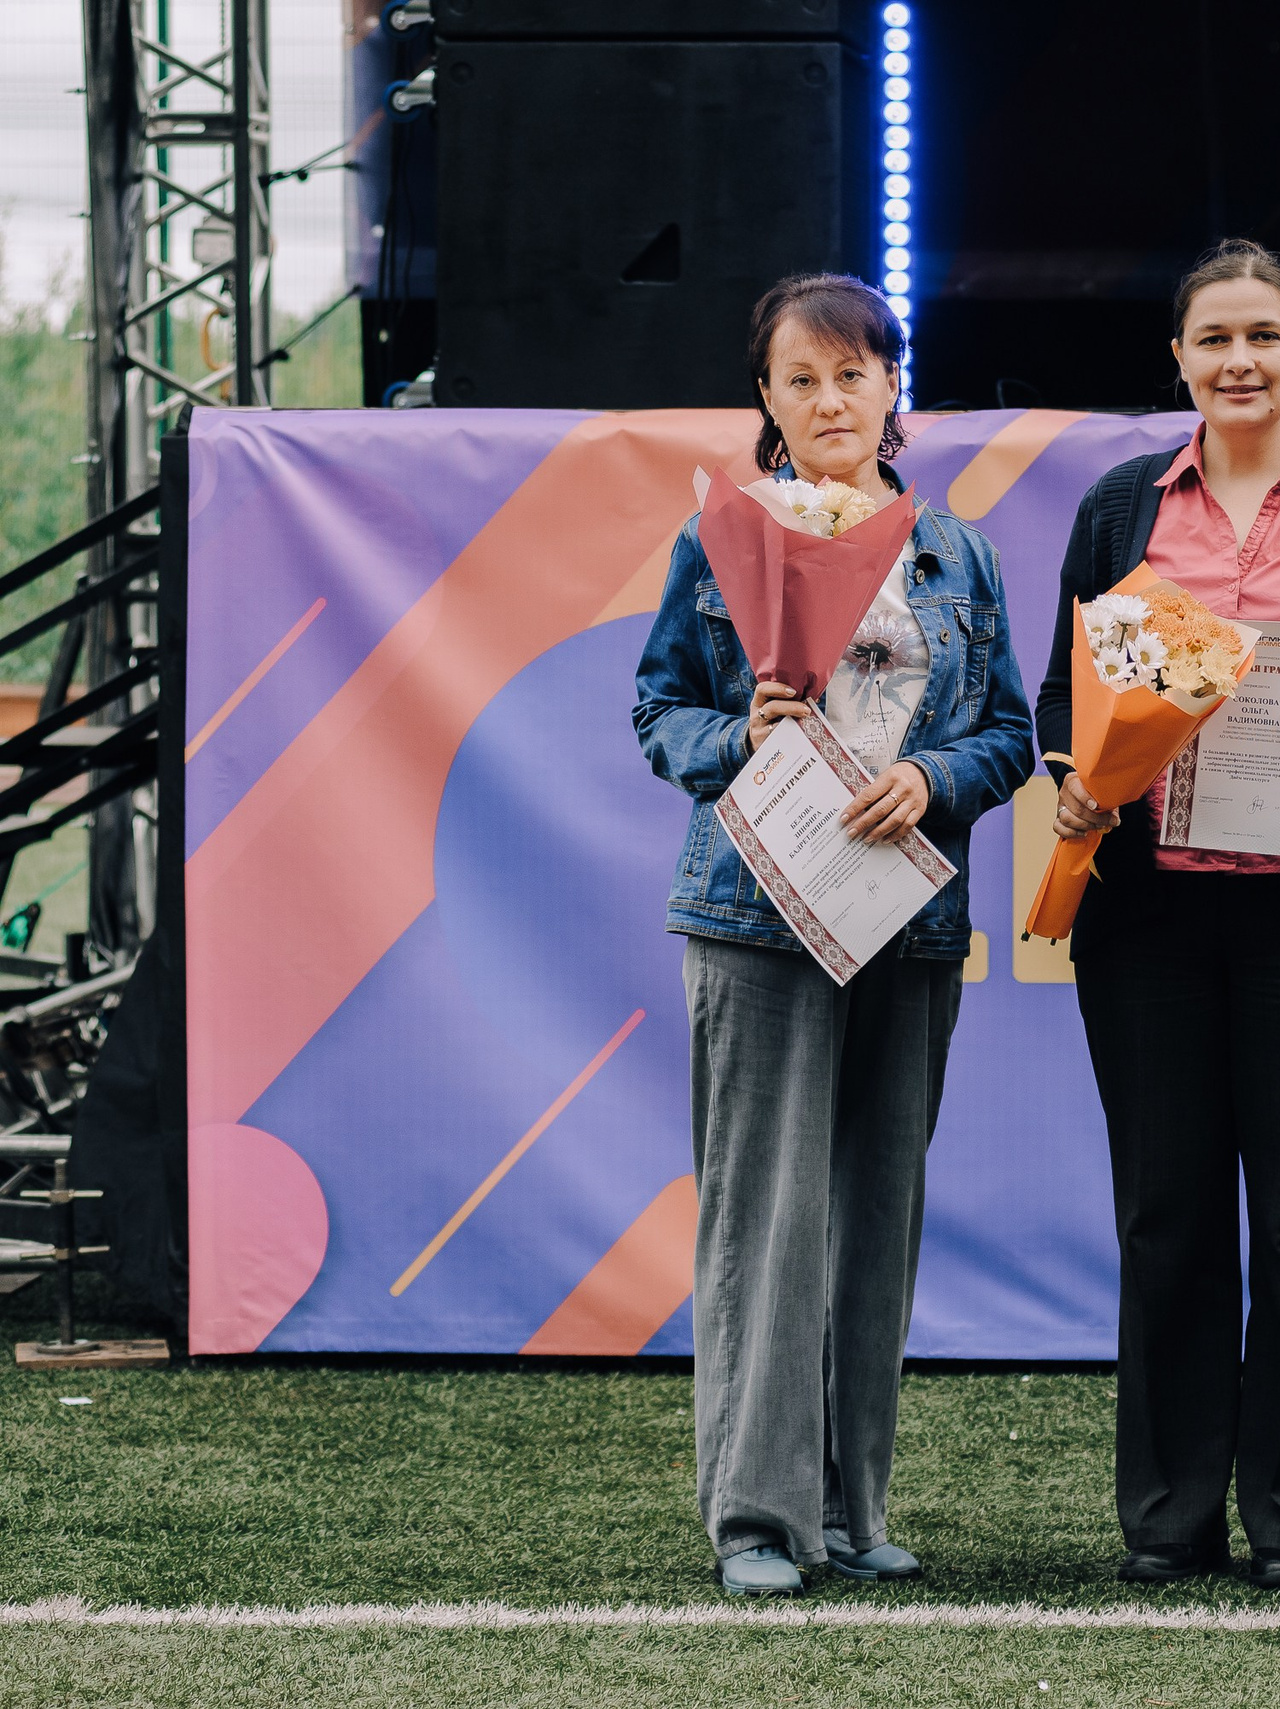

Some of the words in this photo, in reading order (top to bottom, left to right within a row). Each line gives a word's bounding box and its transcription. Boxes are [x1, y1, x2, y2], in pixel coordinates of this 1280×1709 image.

[1233, 695, 1279, 705] СОКОЛОВА
[1242, 707, 1269, 716] ОЛЬГА
[763, 749, 782, 772] УГМК
[1224, 757, 1268, 765] профессиональные
[1225, 769, 1271, 777] профессиональным
[753, 787, 787, 827] ПОЧЕТНАЯ
[784, 757, 817, 791] ГРАМОТА
[790, 804, 814, 830] БЕЛОВА
[794, 810, 822, 840] ЗИНФИРА
